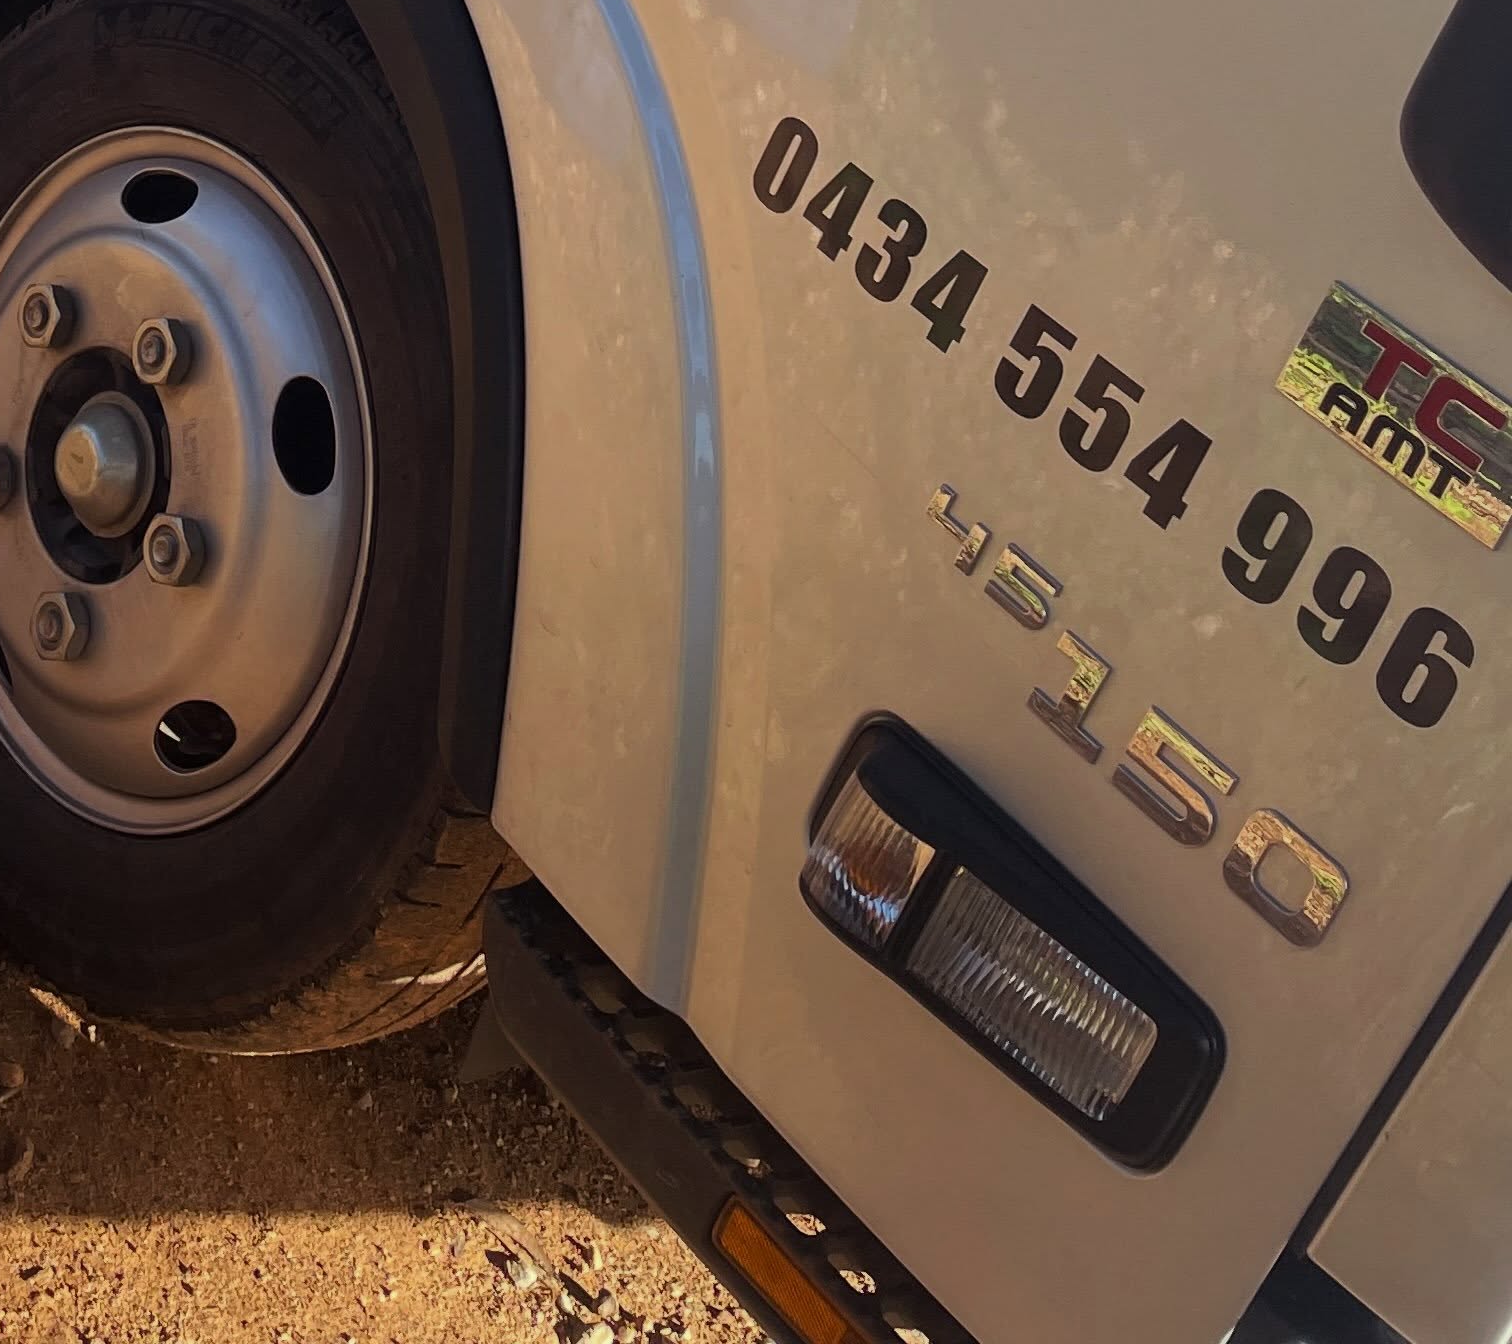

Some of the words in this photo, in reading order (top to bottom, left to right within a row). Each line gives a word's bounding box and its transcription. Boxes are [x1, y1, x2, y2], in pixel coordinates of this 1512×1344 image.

[751, 116, 990, 355] 0434
[993, 304, 1213, 532] 554
[1221, 488, 1476, 729] 996
[1318, 382, 1474, 500] AMT
[1360, 318, 1509, 473] TC
